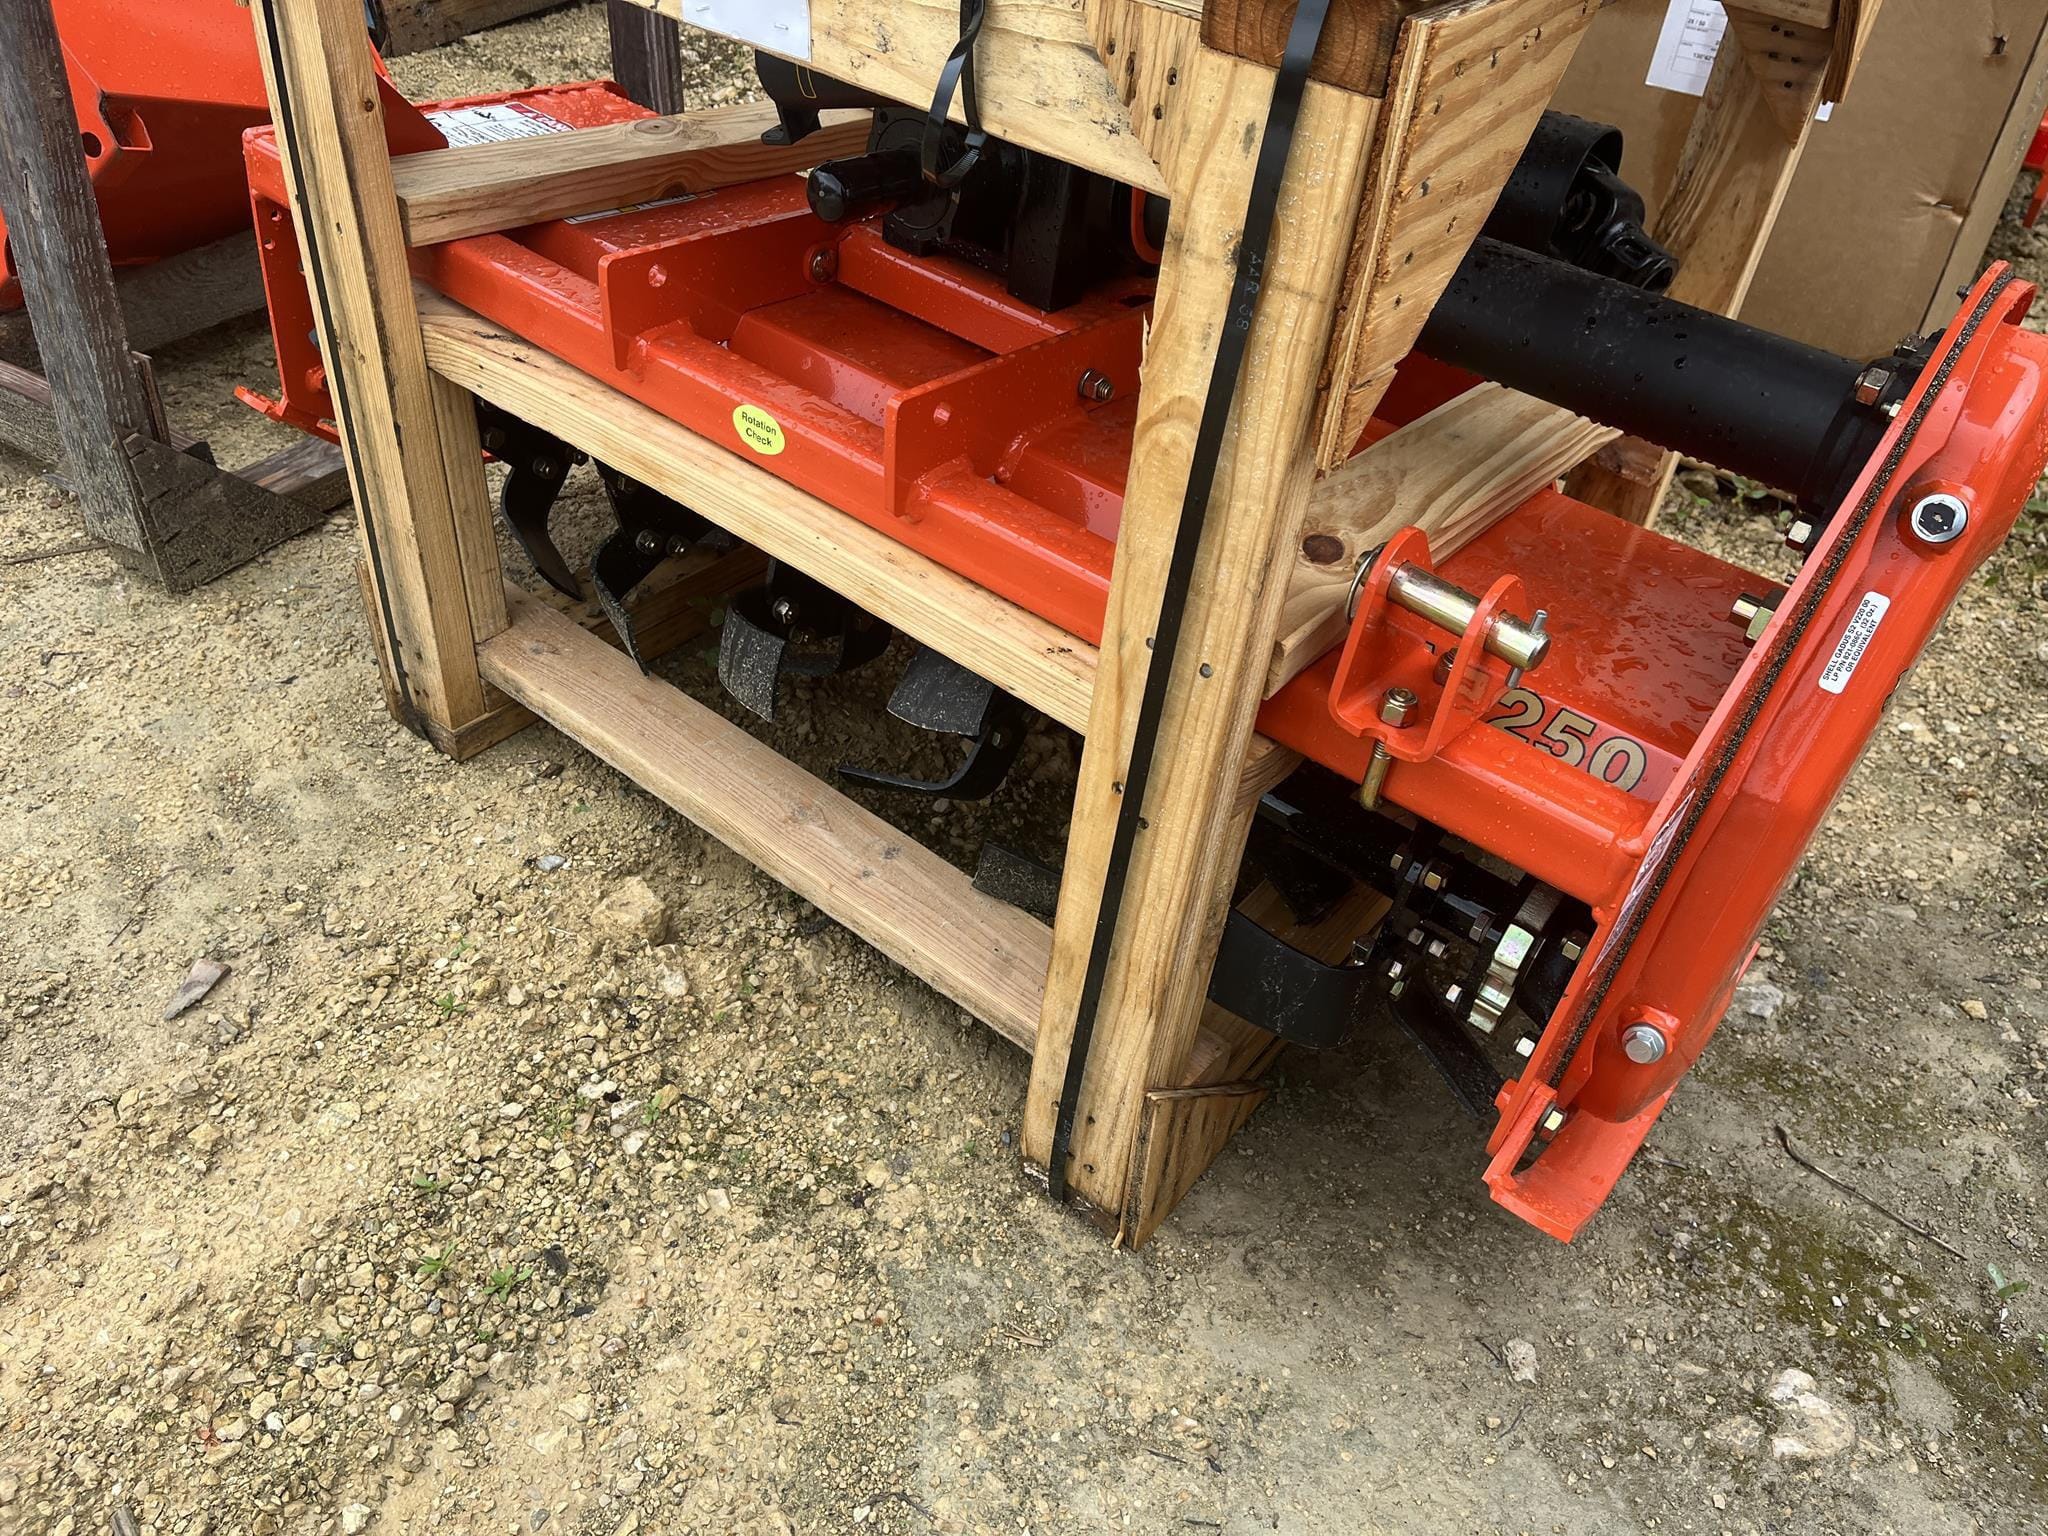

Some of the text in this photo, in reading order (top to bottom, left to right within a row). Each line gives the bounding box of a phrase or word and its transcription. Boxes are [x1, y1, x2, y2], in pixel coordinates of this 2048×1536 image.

[741, 411, 777, 436] Rotation
[745, 427, 772, 448] Check
[1823, 599, 1871, 681] SHELL GADUS S2 V220 00
[1845, 619, 1878, 672] OR EQUIVALENT
[1831, 672, 1840, 682] LP
[1838, 661, 1847, 672] P/N
